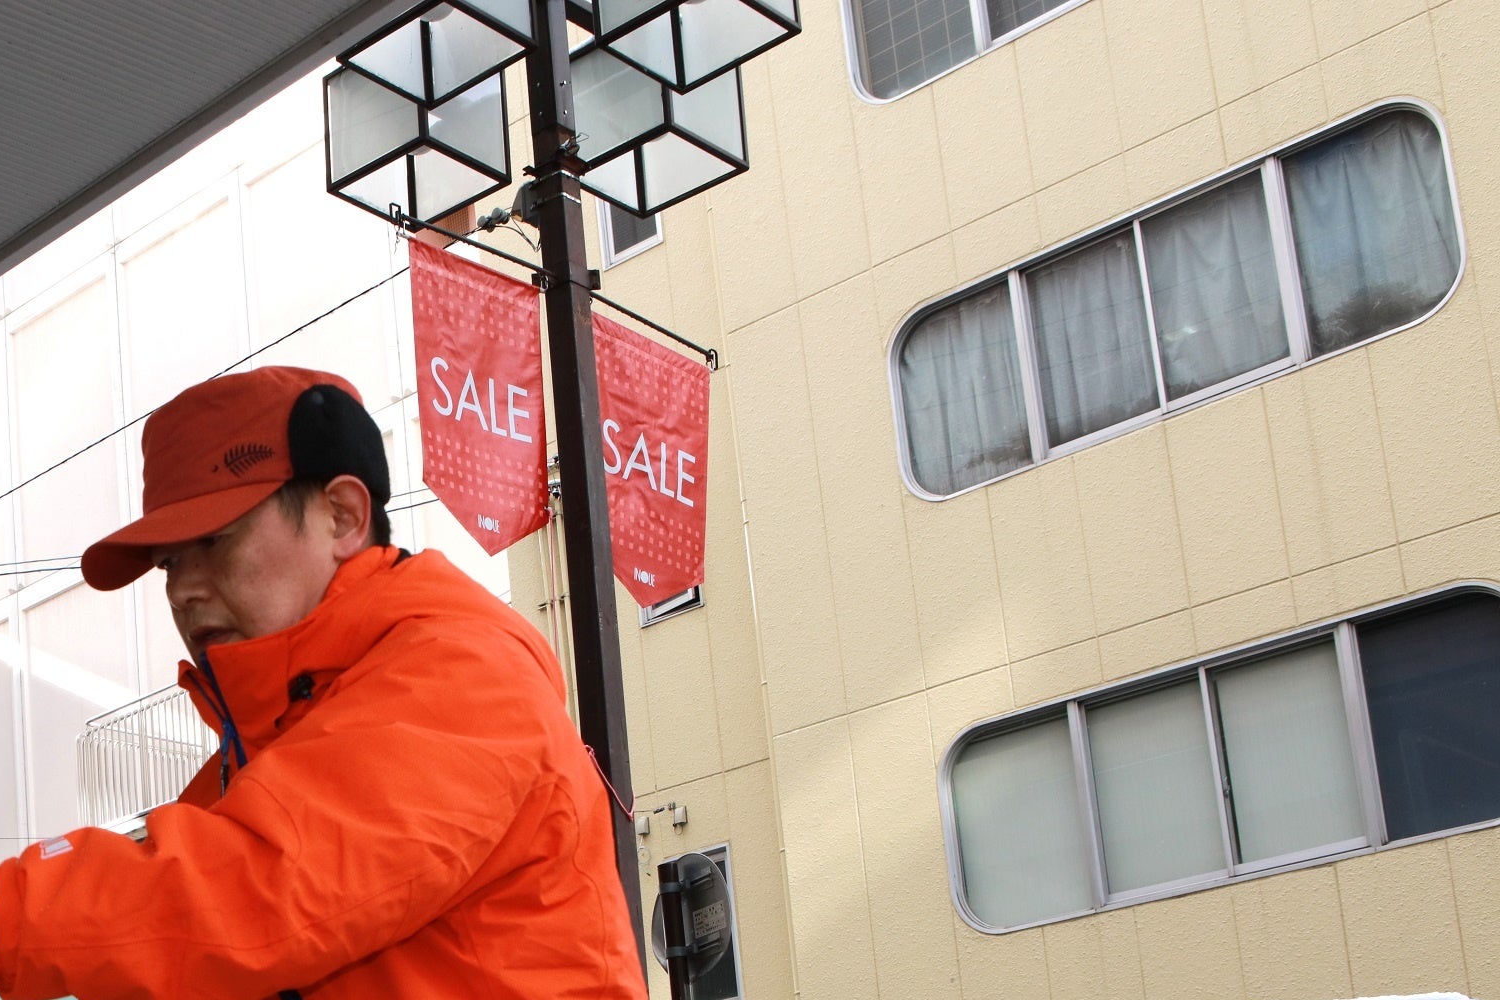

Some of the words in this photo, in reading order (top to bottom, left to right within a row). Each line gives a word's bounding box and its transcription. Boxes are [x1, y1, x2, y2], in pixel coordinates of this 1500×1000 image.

[430, 356, 533, 444] SALE
[602, 418, 697, 508] SALE
[477, 513, 500, 535] INOUE
[633, 567, 656, 588] INOUE
